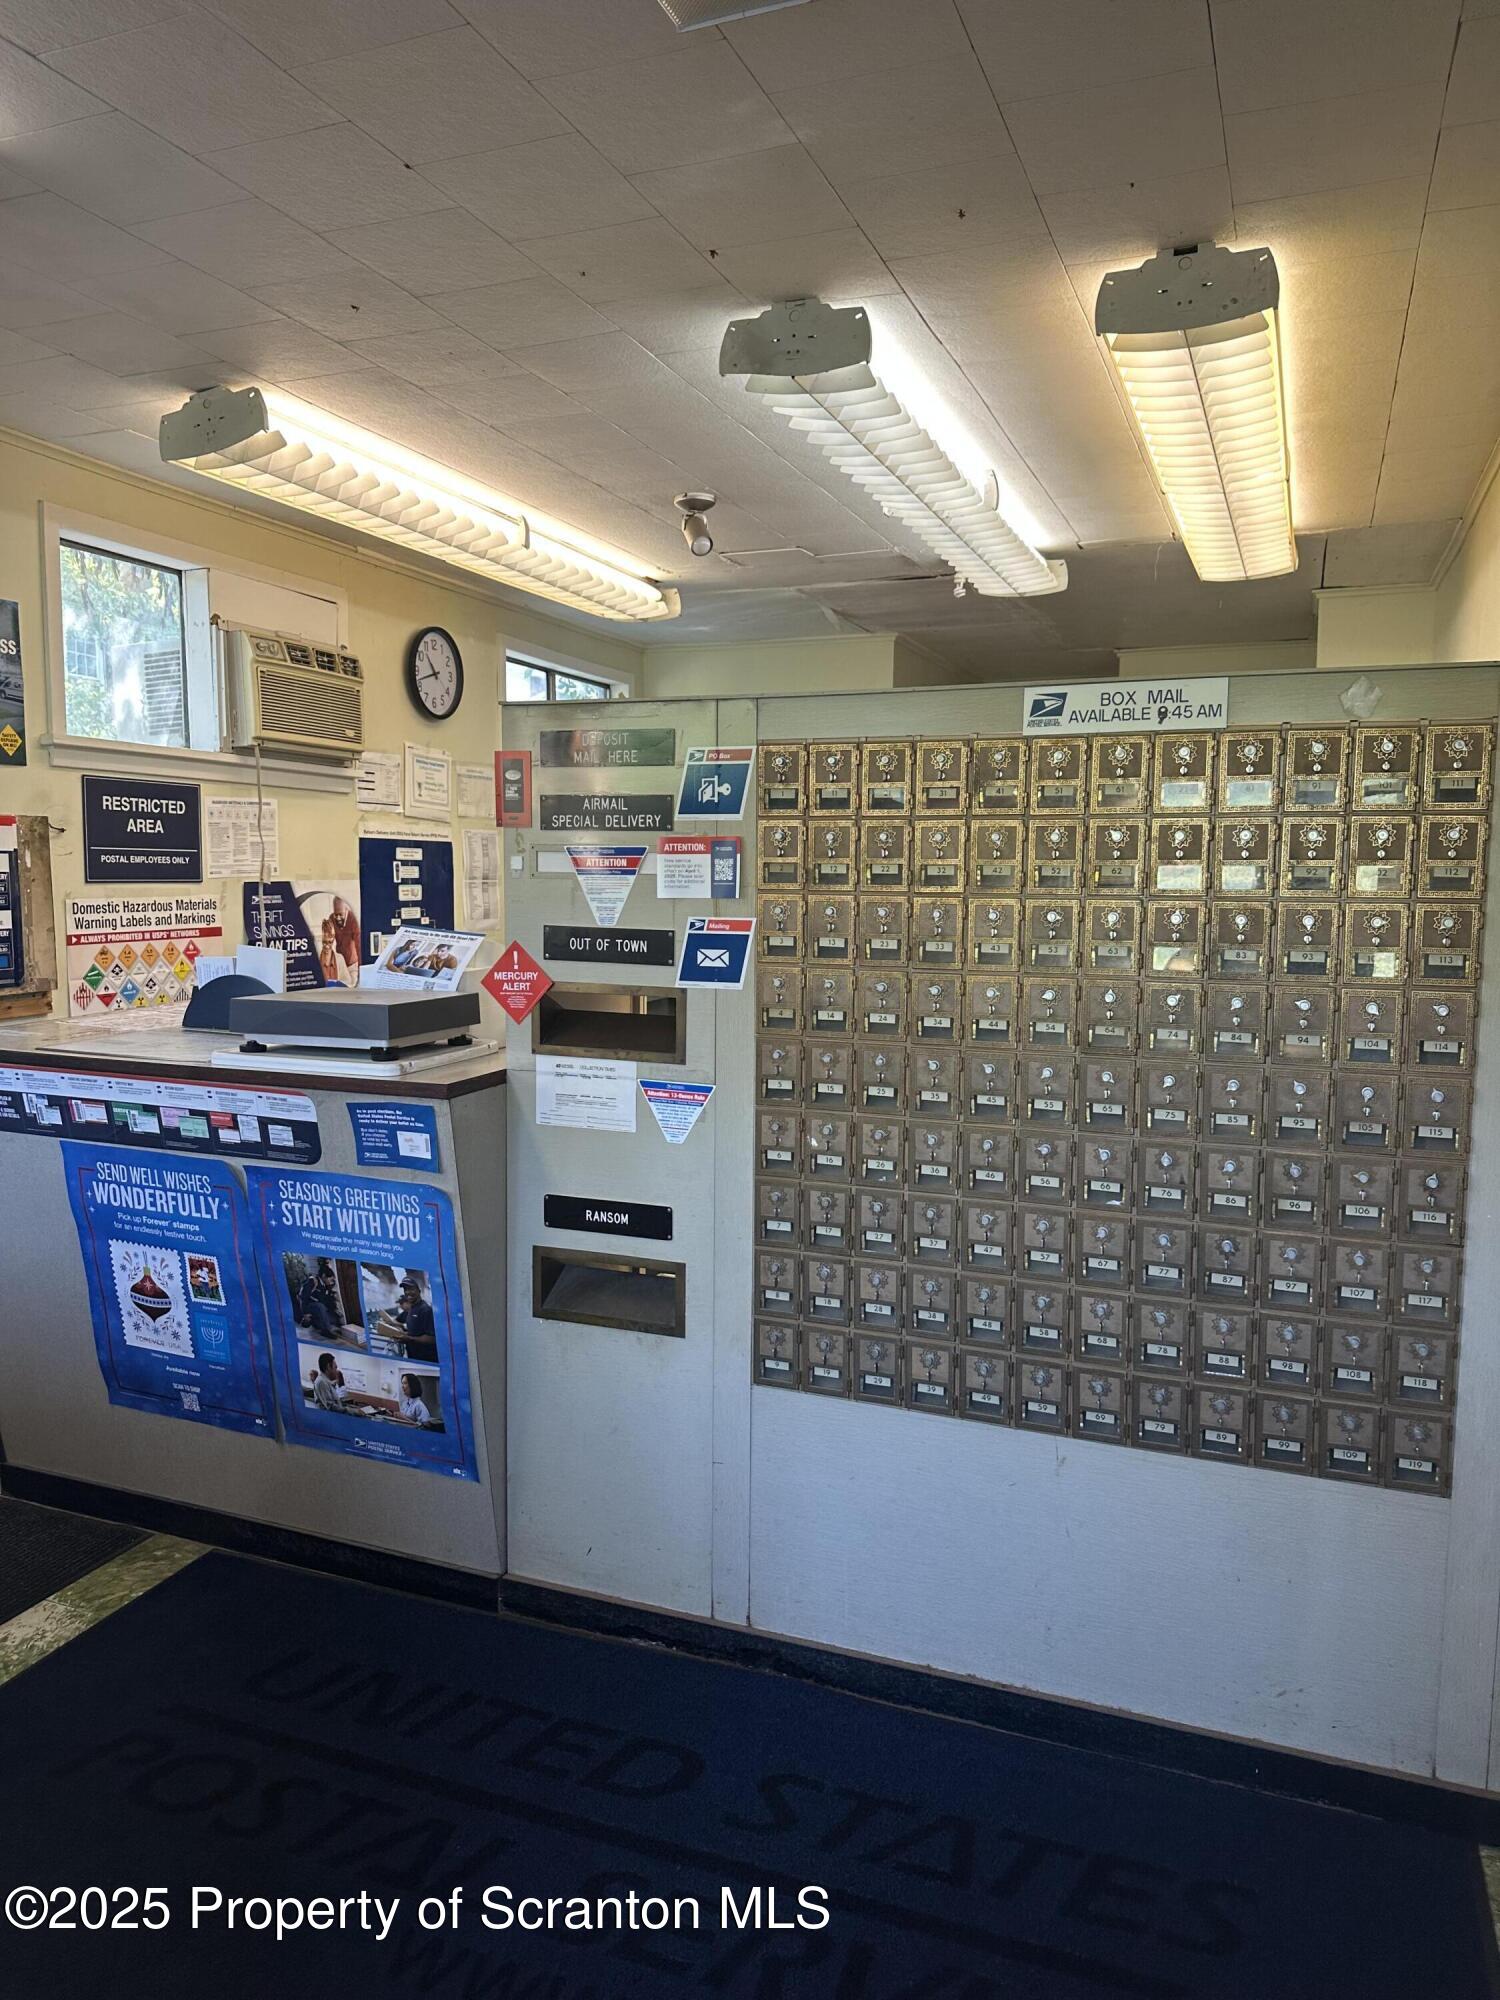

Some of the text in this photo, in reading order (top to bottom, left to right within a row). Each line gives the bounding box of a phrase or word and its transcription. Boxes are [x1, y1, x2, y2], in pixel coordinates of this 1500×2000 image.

[424, 640, 428, 651] 11
[430, 640, 438, 650] 12
[440, 645, 443, 654] 1
[418, 650, 424, 661] 10
[446, 656, 450, 667] 2
[448, 672, 452, 682] 3
[424, 693, 428, 702] 7
[446, 687, 450, 697] 4
[1100, 689, 1189, 706] BOX MAIL
[432, 697, 436, 708] 6
[440, 695, 444, 706] 5
[1069, 707, 1150, 723] AVAILABLE
[1197, 704, 1222, 718] AM
[582, 732, 629, 745] DEPOSIT
[574, 750, 638, 763] MAIL HERE
[1054, 786, 1063, 794] 51
[102, 796, 186, 814] RESTRICTED
[583, 797, 628, 810] AIRMAIL
[127, 819, 164, 834] AREA
[552, 815, 661, 828] SPECIAL DELIVERY
[101, 855, 129, 863] POSTAL
[130, 856, 170, 864] EMPLOYEES
[586, 859, 627, 867] ATTENTION
[1051, 865, 1061, 874] 52
[1306, 868, 1318, 876] 92
[1445, 867, 1459, 876] 112
[72, 899, 217, 915] Domestic Hazardous Materials
[75, 913, 215, 930] Warning Labels and Markings
[709, 922, 730, 930] Mailing
[80, 934, 106, 943] ALWAYS
[108, 932, 142, 942] PROHIBITED
[286, 938, 308, 951] TIPS
[570, 938, 647, 953] OUT OF TOWN
[1440, 956, 1453, 964] 113
[494, 971, 538, 981] MERCURY
[502, 982, 531, 991] ALERT
[97, 1162, 211, 1194] SEND WELL WISHES
[92, 1181, 220, 1220] WONDERFULLY
[278, 1180, 420, 1215] SEASON'S GREETINGS
[117, 1212, 131, 1221] Pick
[173, 1221, 199, 1231] stamps
[282, 1201, 420, 1242] START WITH YOU
[585, 1210, 629, 1224] RANSOM
[134, 1225, 162, 1237] endlessly
[164, 1229, 184, 1239] festive
[312, 1232, 342, 1243] appreciate
[372, 1241, 391, 1249] wishes
[327, 1243, 349, 1252] happen
[242, 1650, 704, 1801] UNITED
[721, 1773, 1258, 1958] STATES
